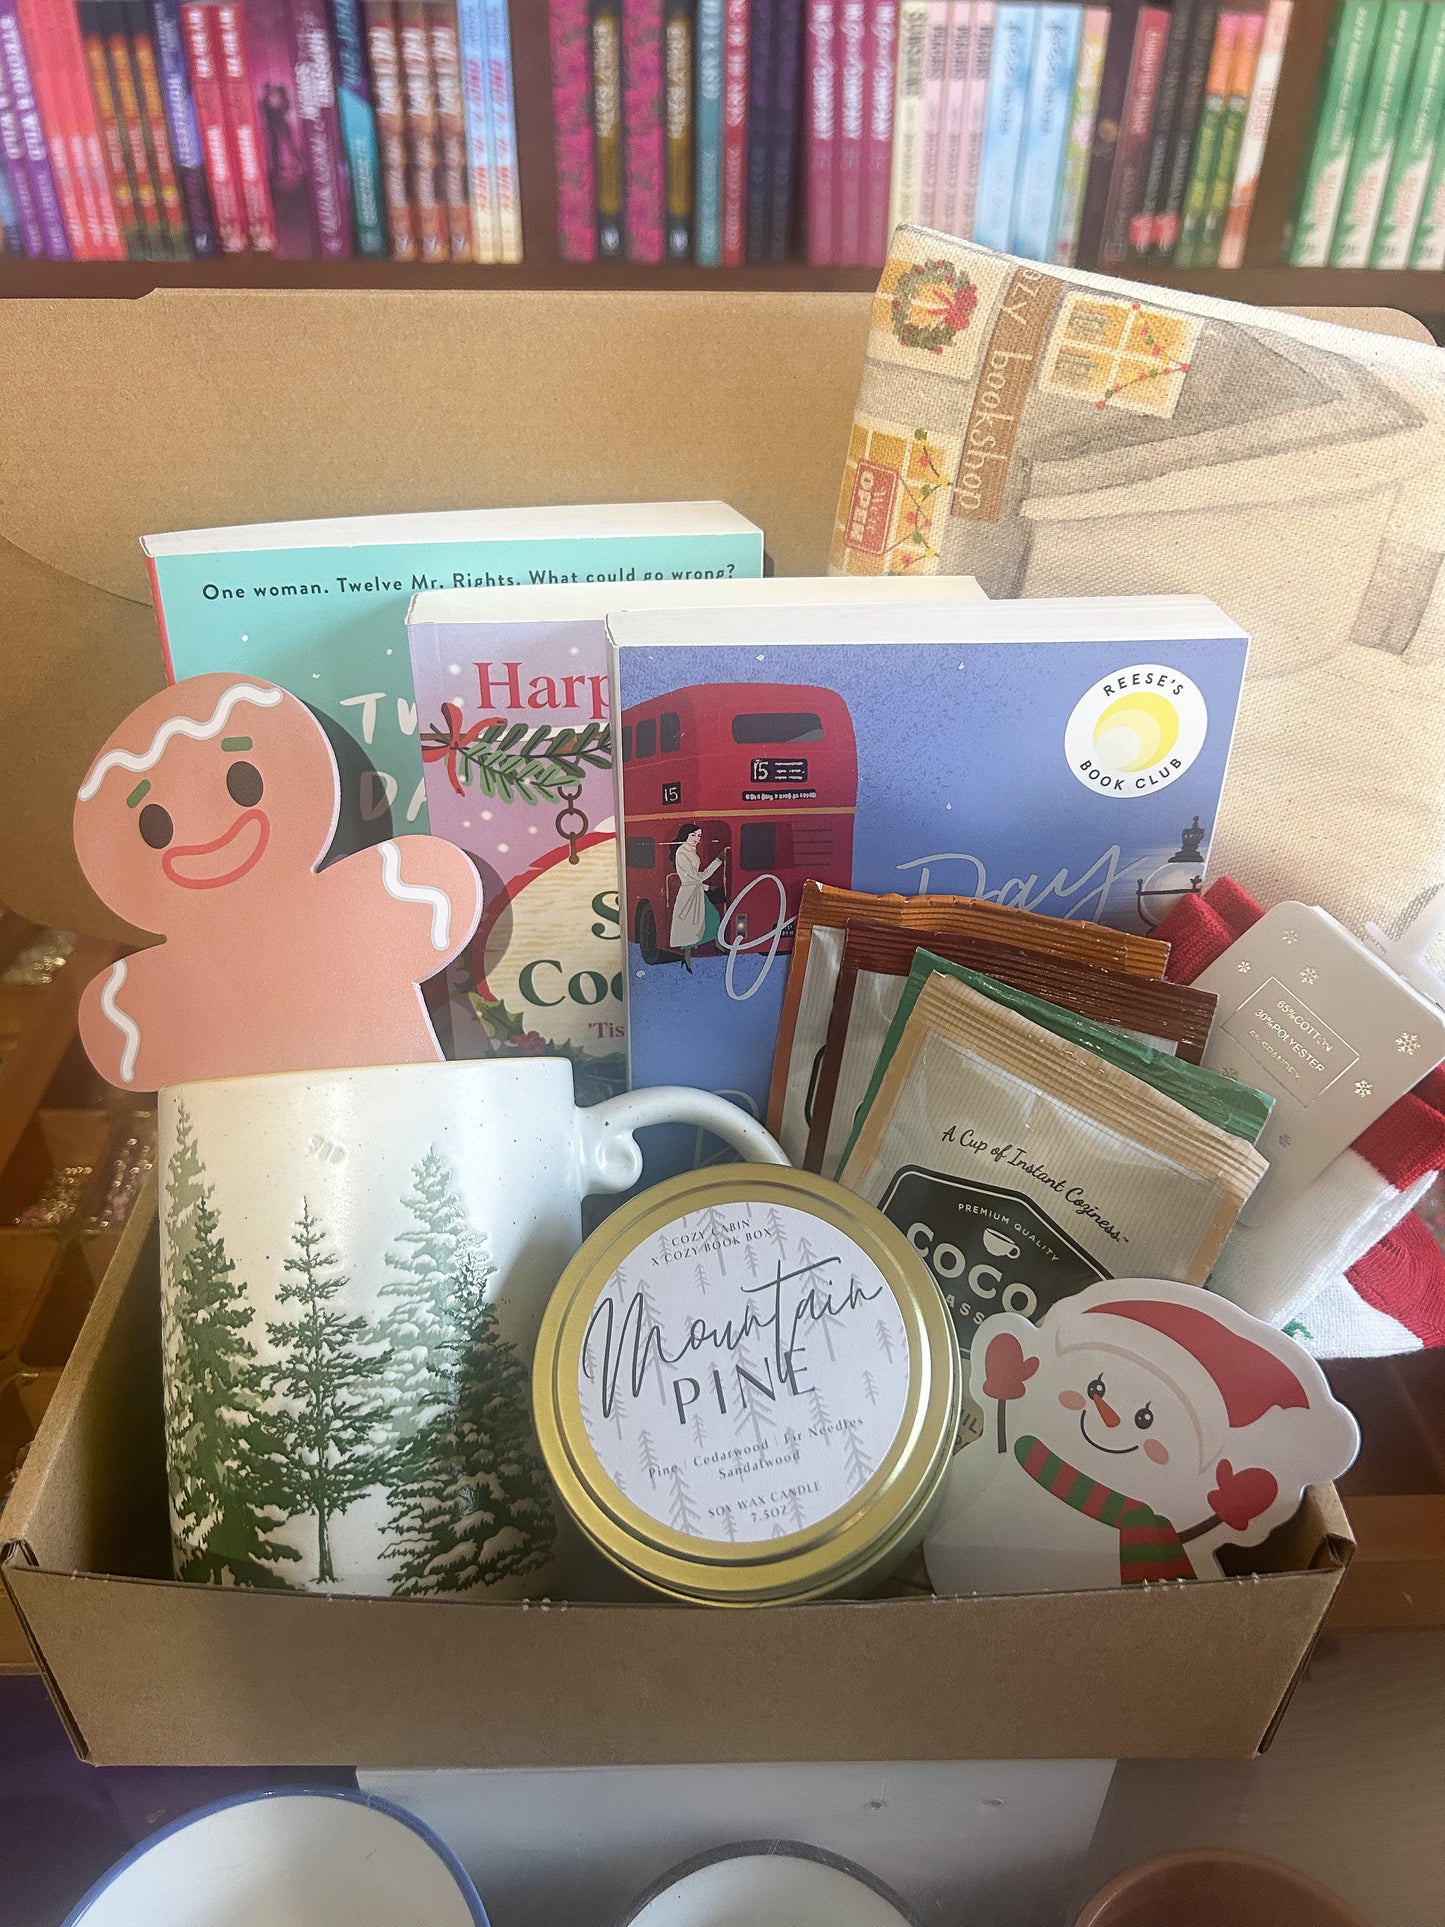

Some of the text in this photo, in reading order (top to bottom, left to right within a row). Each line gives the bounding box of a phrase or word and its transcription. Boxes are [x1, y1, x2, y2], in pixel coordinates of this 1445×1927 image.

[953, 349, 1034, 510] bookshop
[202, 583, 246, 600] One
[253, 576, 329, 598] woman.
[336, 576, 402, 593] Twelve
[411, 573, 444, 590] Mr.
[529, 570, 578, 584] What
[586, 568, 635, 582] could
[1103, 672, 1184, 697] REESE'S
[753, 760, 769, 780] 15
[1080, 758, 1182, 791] BOOK CLUB
[664, 788, 679, 802] 15
[941, 1125, 957, 1143] A
[959, 1129, 988, 1154] Cup
[990, 1143, 1013, 1163] of
[1007, 1148, 1067, 1193] Instant
[664, 1247, 698, 1263] COZY
[704, 1237, 741, 1252] BOOK
[745, 1227, 772, 1242] BOX
[671, 1219, 750, 1247] COZY CABIN
[958, 1203, 1059, 1262] PREMIUM QUALITY
[906, 1222, 1038, 1319] COCO
[582, 1256, 883, 1419] Mountain
[673, 1347, 816, 1425] PINE
[648, 1463, 678, 1480] Pine
[693, 1438, 770, 1468] Cedarwood
[808, 1417, 864, 1439] Needles
[718, 1451, 802, 1480] Sandalwood
[707, 1481, 822, 1519] SOY WAX CANDLE
